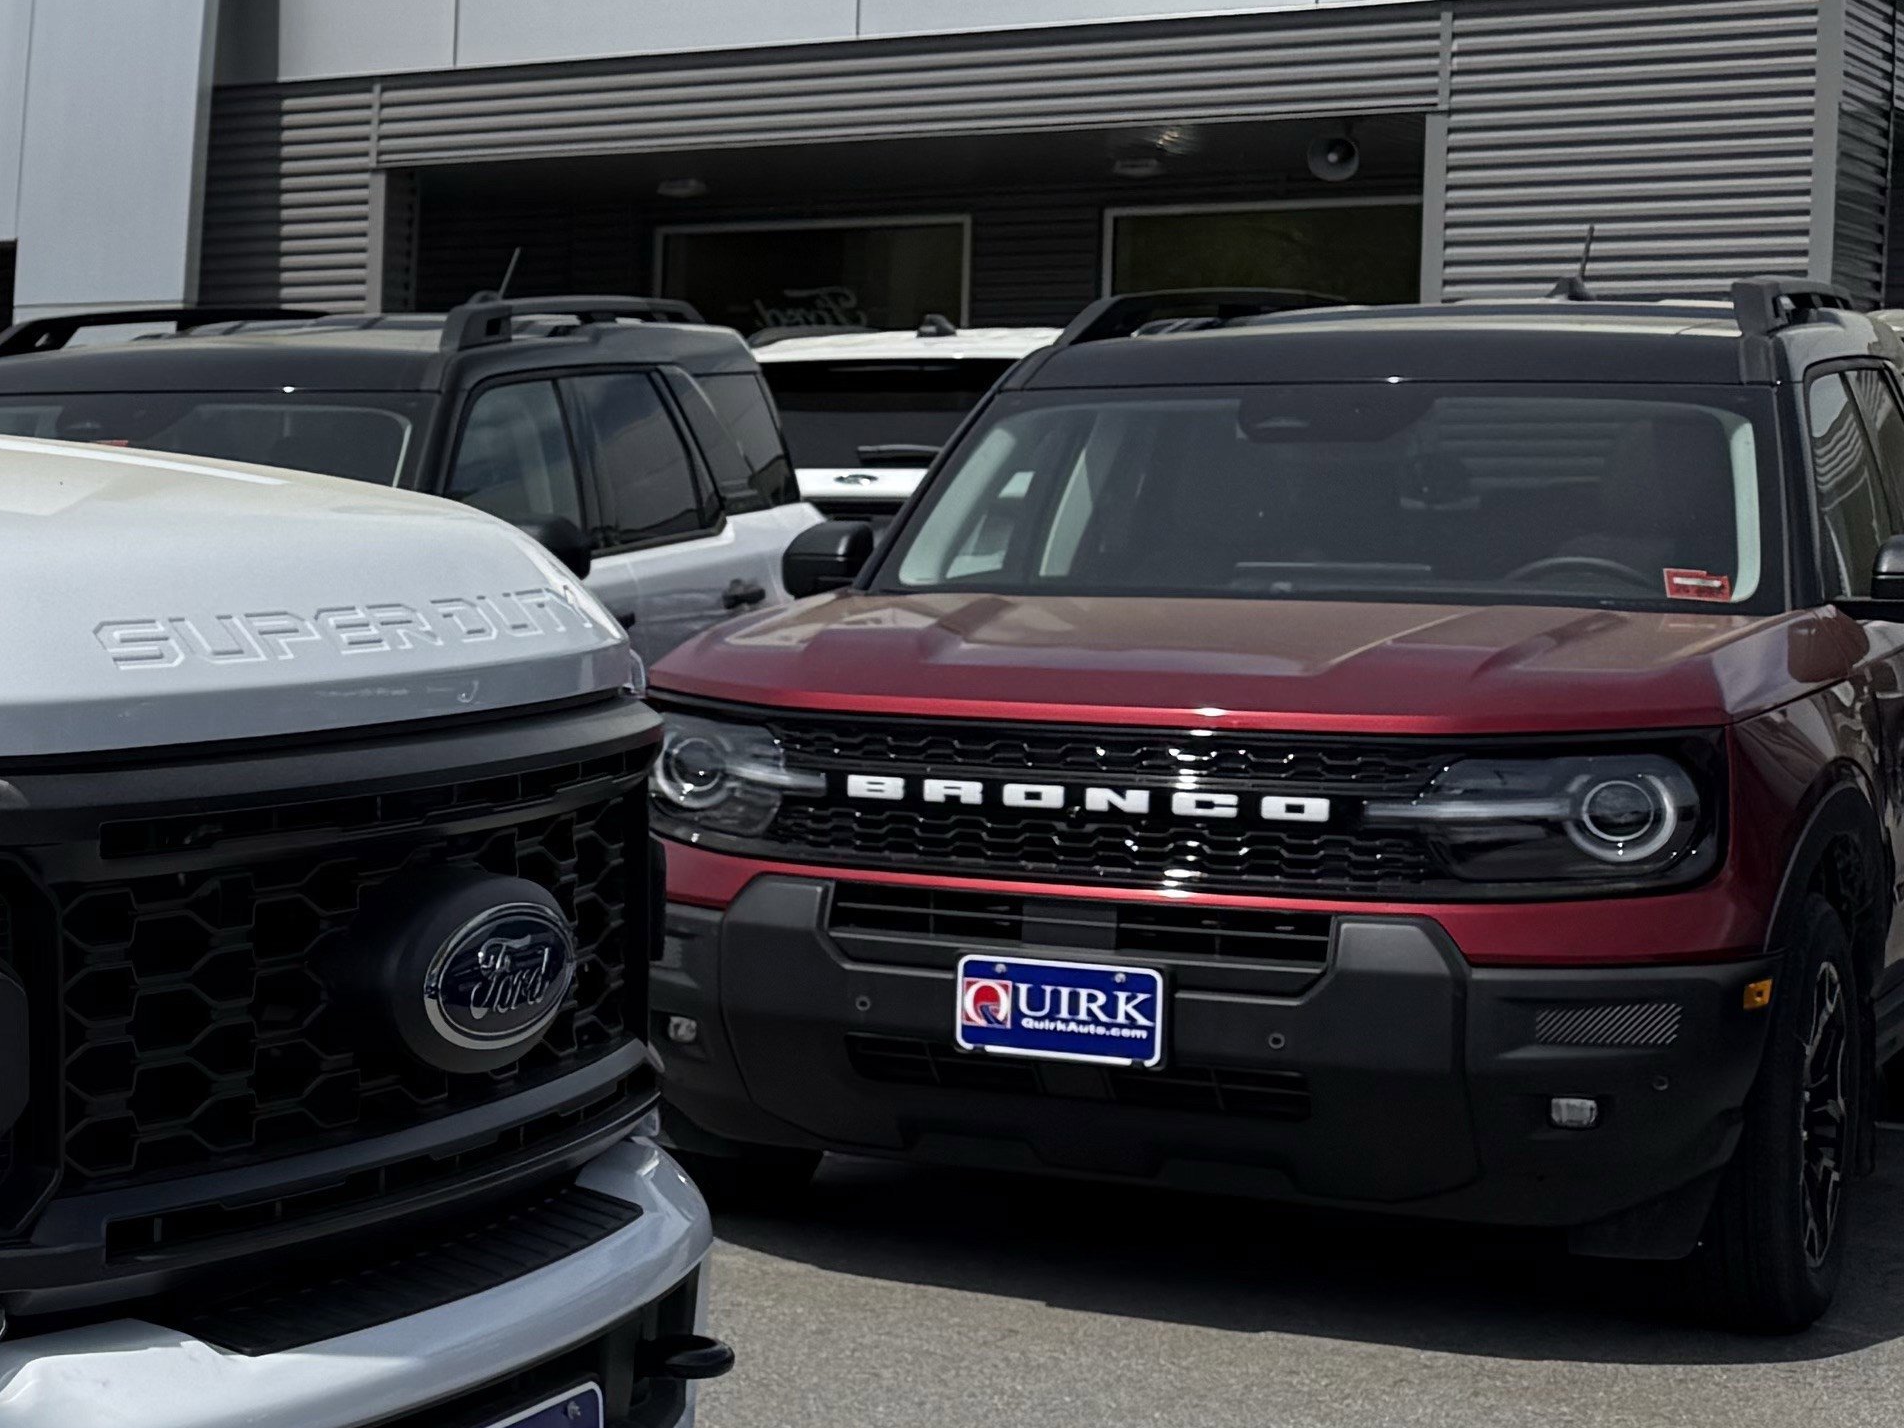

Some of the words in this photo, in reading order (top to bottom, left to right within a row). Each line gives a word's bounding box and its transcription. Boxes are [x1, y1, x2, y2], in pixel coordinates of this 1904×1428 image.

[847, 774, 1330, 823] BRONCO
[470, 934, 550, 1020] Ford
[964, 979, 1155, 1029] QUIRK
[1021, 1017, 1148, 1041] QuirkAuto.com
